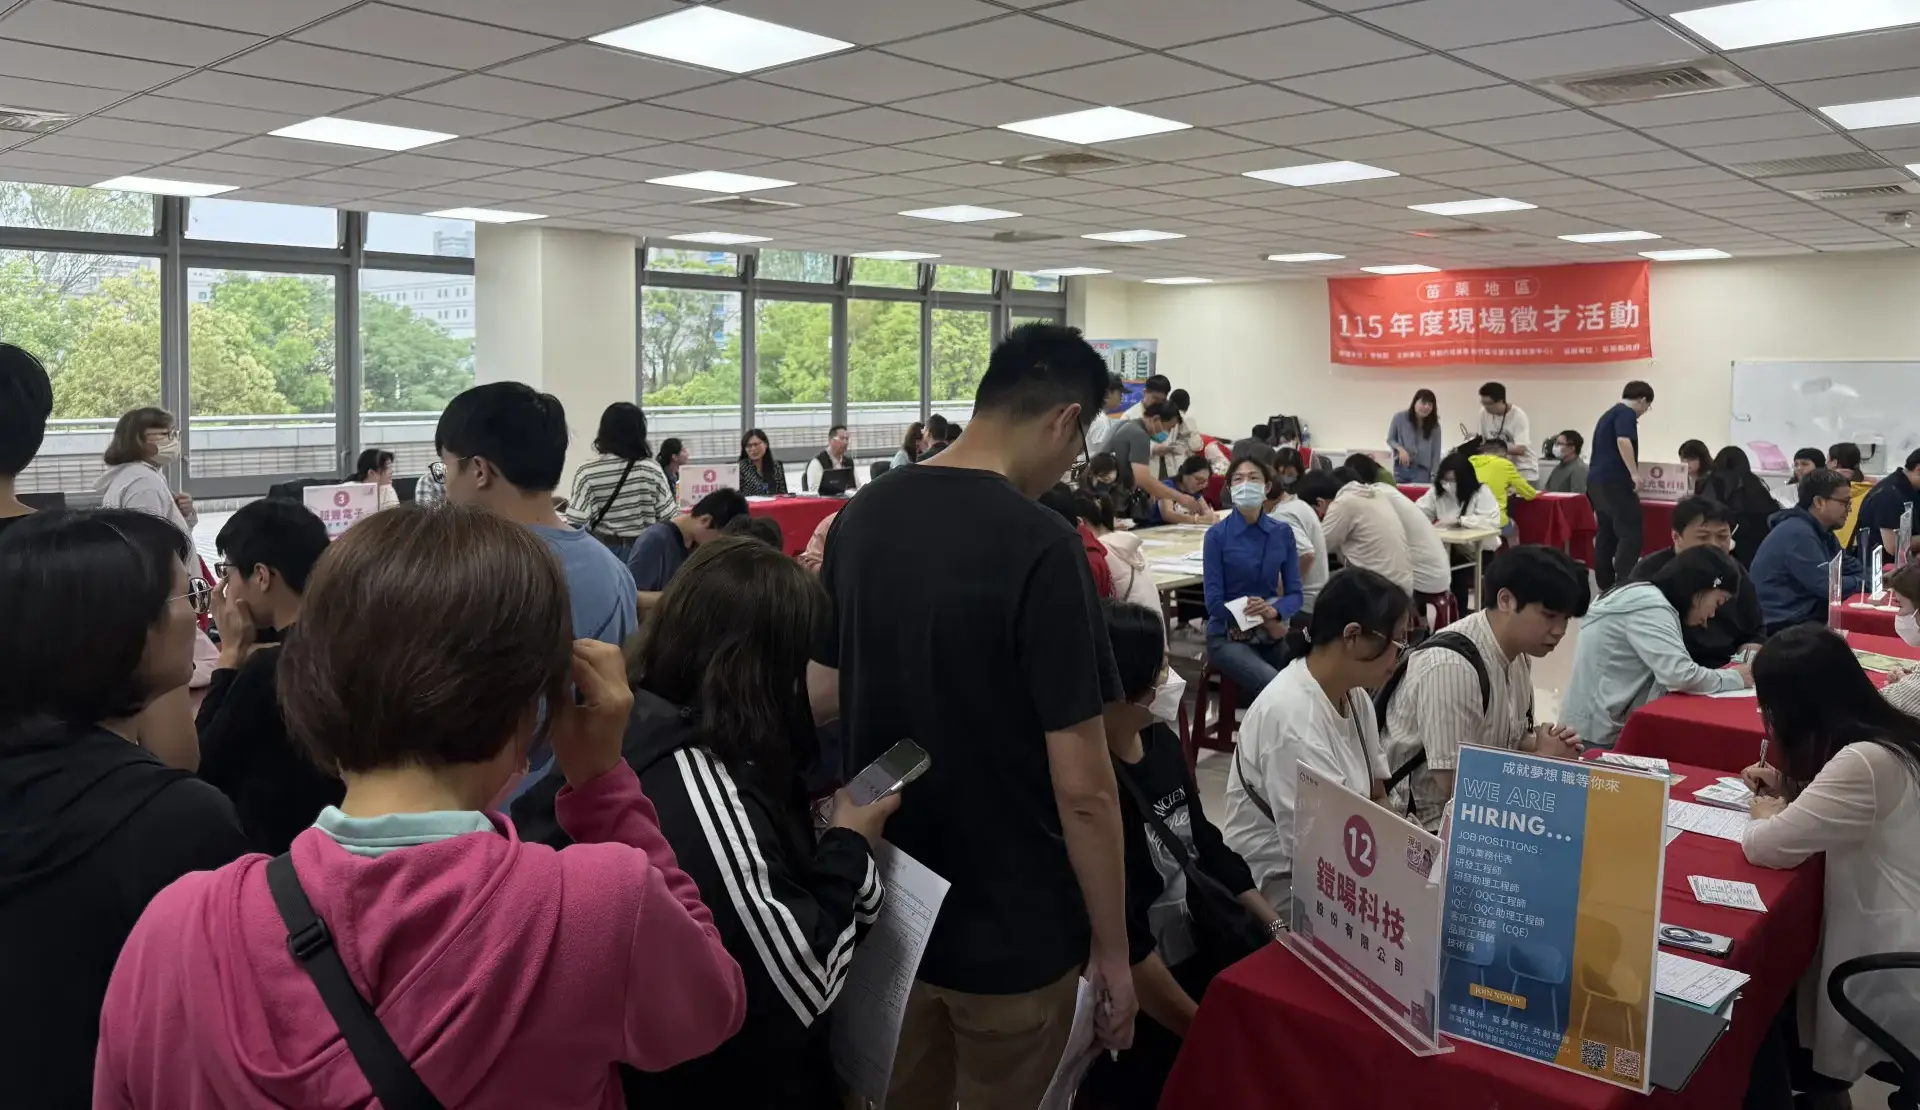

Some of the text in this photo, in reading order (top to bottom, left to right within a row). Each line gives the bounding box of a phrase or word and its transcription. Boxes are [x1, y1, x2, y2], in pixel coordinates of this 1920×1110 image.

[1426, 279, 1531, 300] 苗栗地區
[337, 492, 345, 504] 3
[1502, 761, 1620, 793] 成就夢想 職等你來
[1463, 778, 1556, 813] WE ARE
[1460, 803, 1571, 842] HIRING...
[1349, 827, 1371, 868] 12
[1458, 831, 1477, 842] JOB
[1456, 844, 1512, 864] 國內業務代表
[1455, 858, 1502, 876] 研發工程師
[1453, 870, 1520, 894] 研發助理工程師
[1452, 884, 1468, 896] IQC
[1475, 889, 1495, 902] OQC
[1497, 894, 1527, 908] 工程師
[1452, 898, 1467, 909] IQC
[1474, 903, 1494, 916] OQC
[1496, 907, 1545, 928] 助理工程師
[1316, 900, 1404, 976] 股份有限公司
[1447, 937, 1474, 953] 技術員
[1475, 986, 1493, 998] JOIN
[1494, 991, 1514, 1003] NOW
